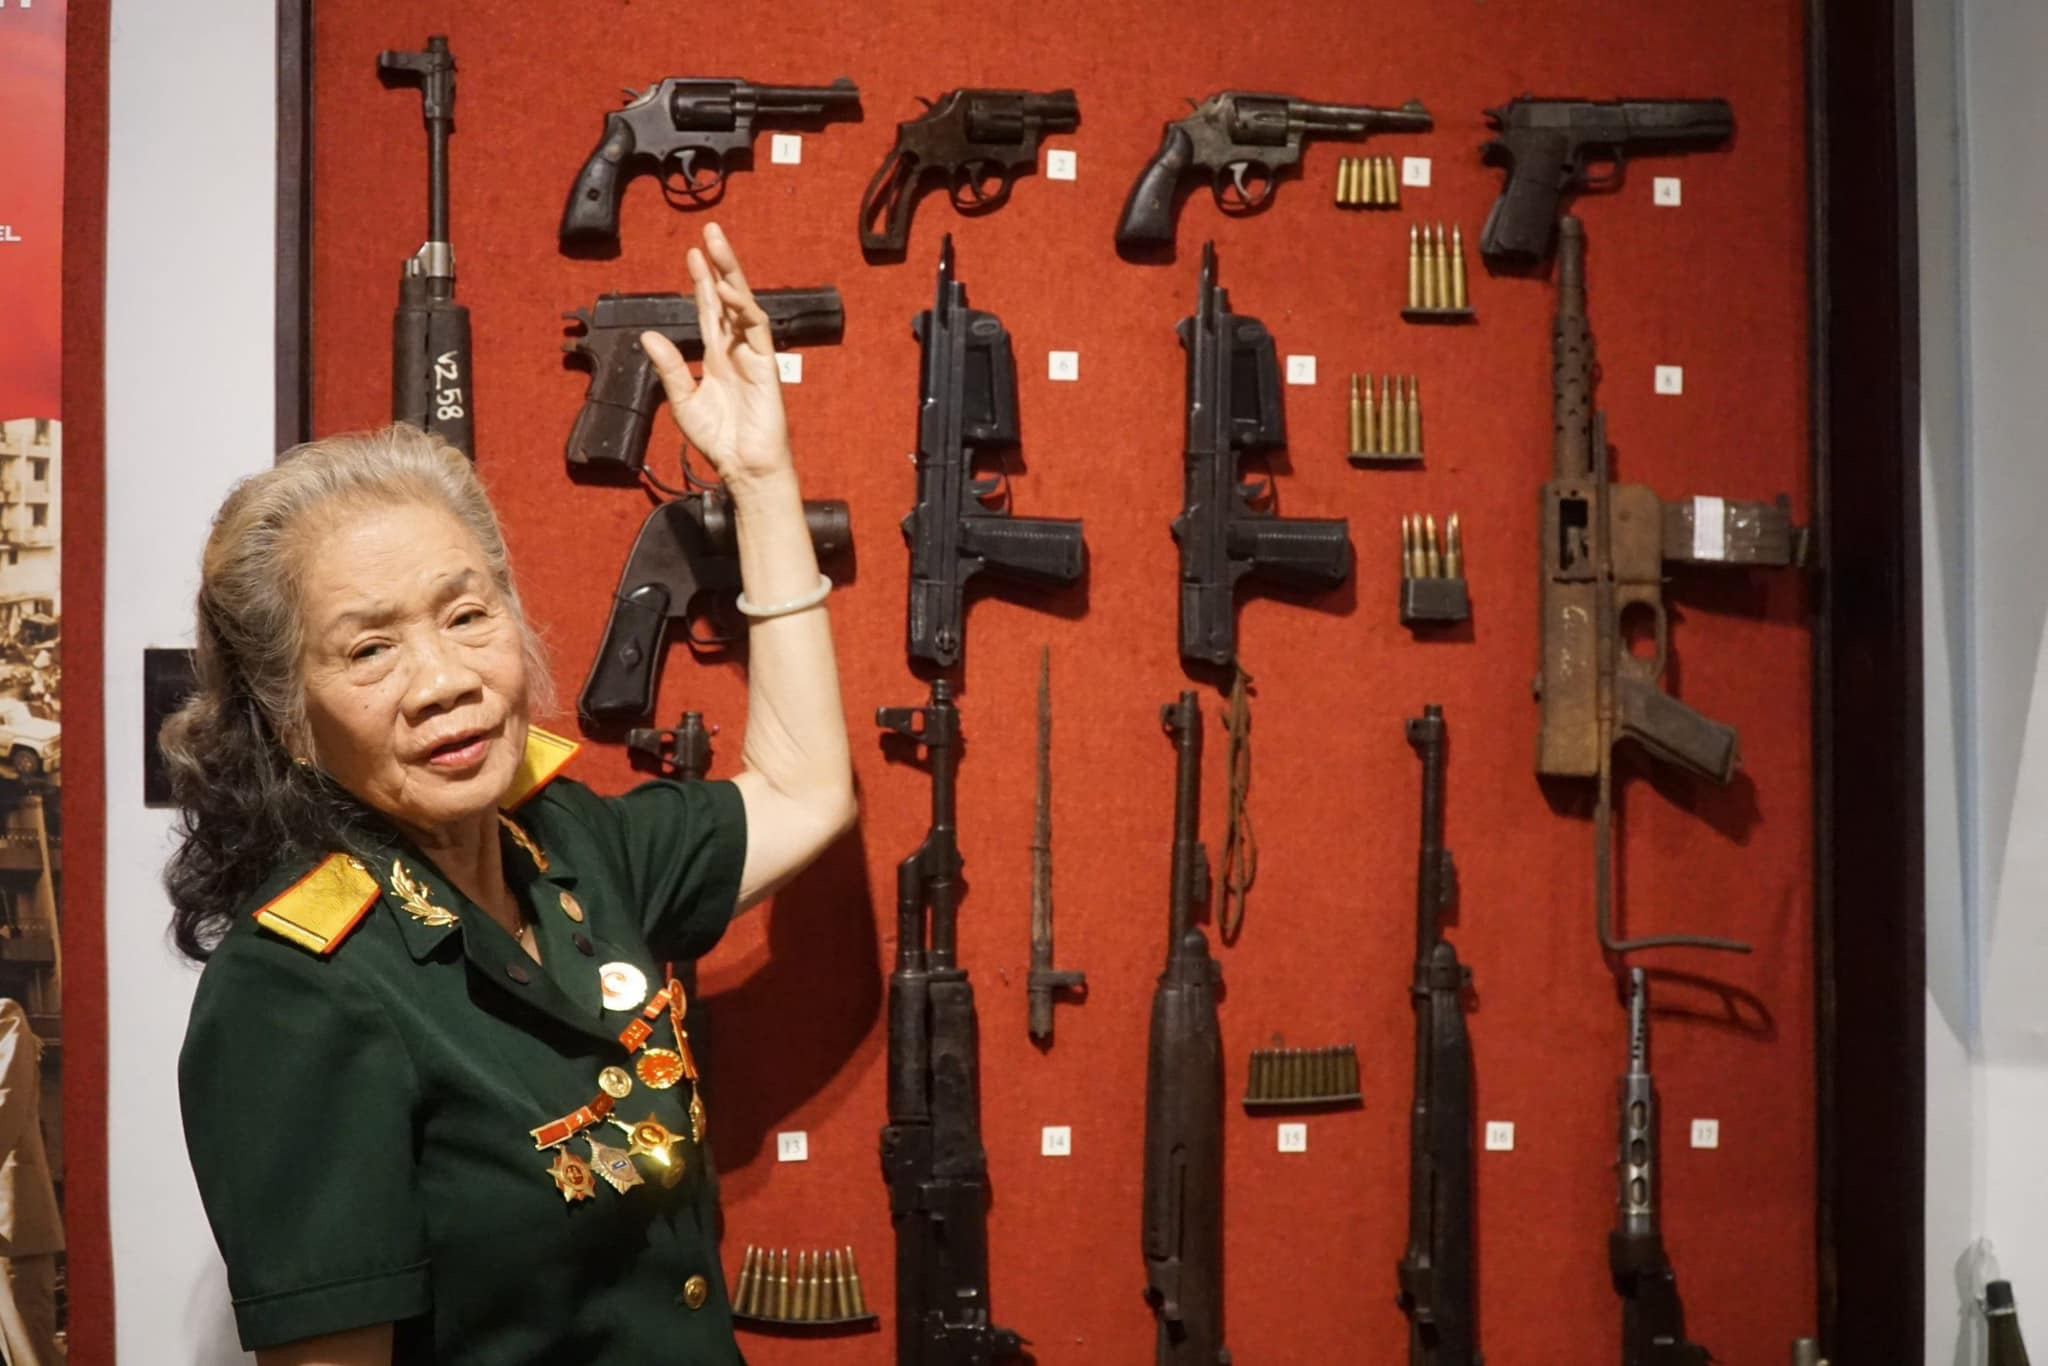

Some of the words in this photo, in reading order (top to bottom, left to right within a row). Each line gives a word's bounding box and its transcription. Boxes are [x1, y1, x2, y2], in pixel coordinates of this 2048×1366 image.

[1056, 158, 1066, 173] 2
[1284, 1131, 1300, 1146] 15
[1493, 1130, 1508, 1144] 16
[1698, 1127, 1713, 1141] 17
[784, 1140, 801, 1153] 13
[1049, 1135, 1066, 1148] 14
